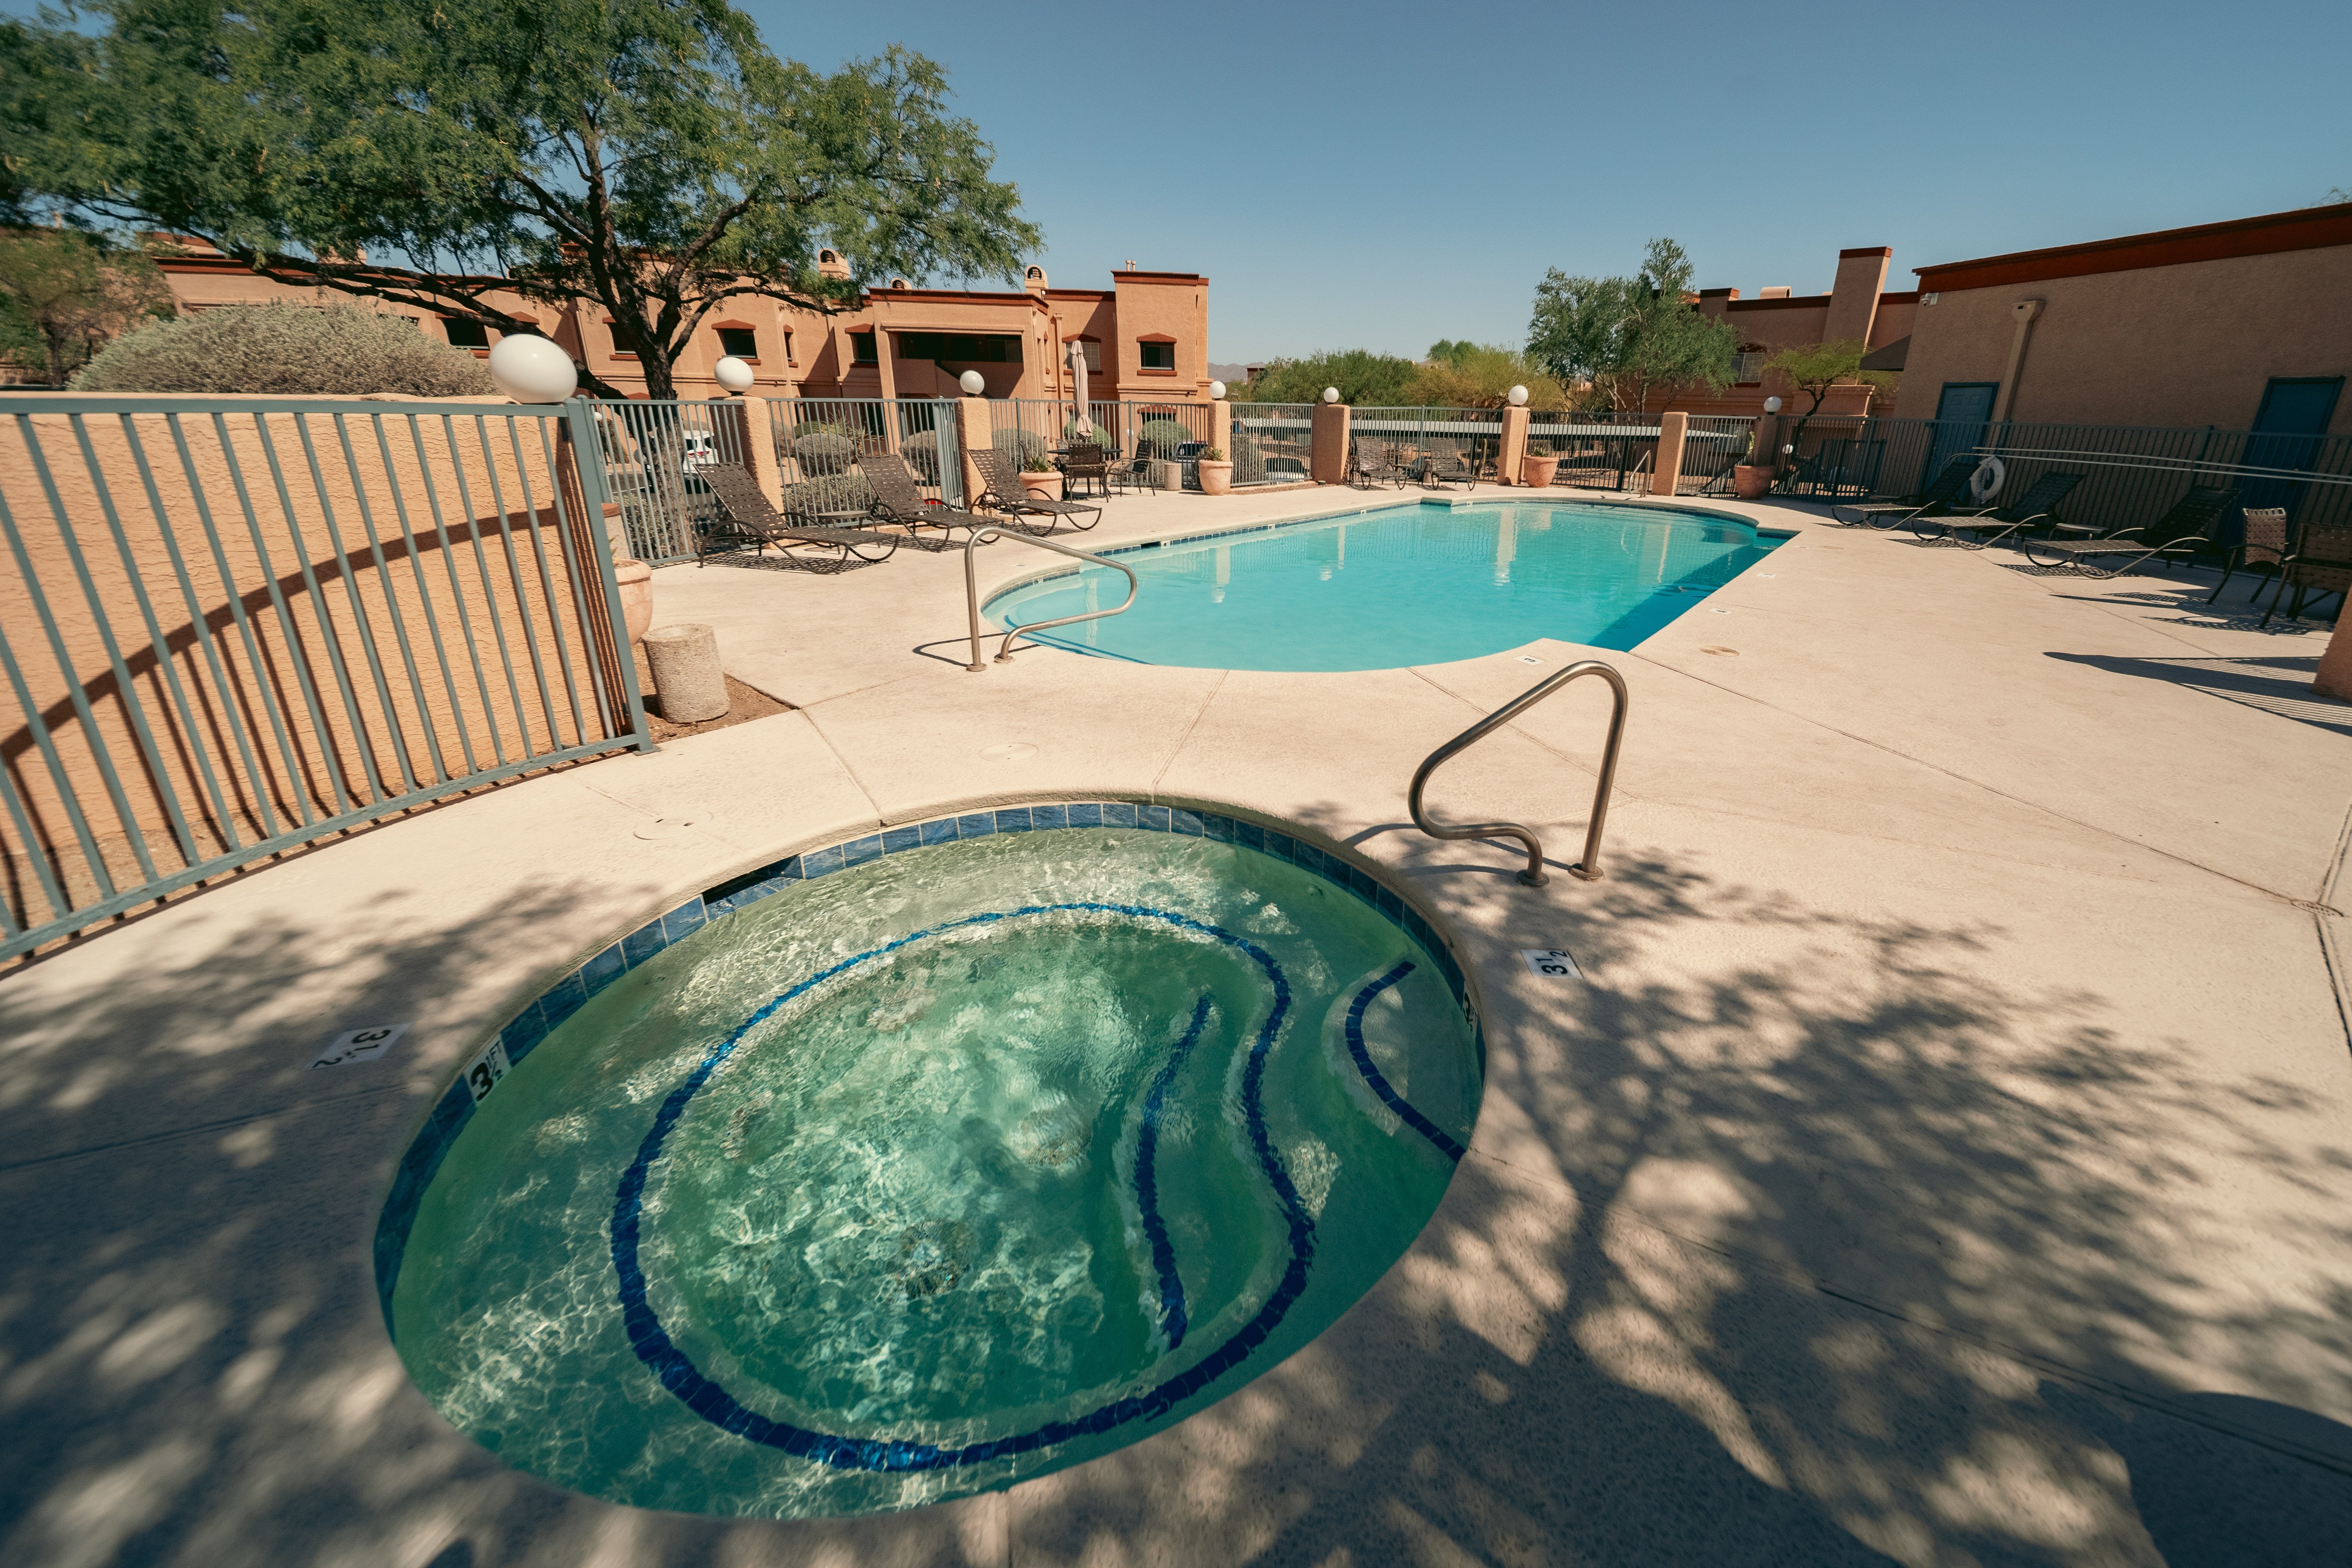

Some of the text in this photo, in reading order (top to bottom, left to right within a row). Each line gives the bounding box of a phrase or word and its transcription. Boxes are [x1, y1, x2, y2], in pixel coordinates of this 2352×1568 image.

[1541, 964, 1568, 974] 3
[351, 1029, 391, 1044] 3
[470, 1062, 493, 1102] 3
[489, 1040, 502, 1061] FT
